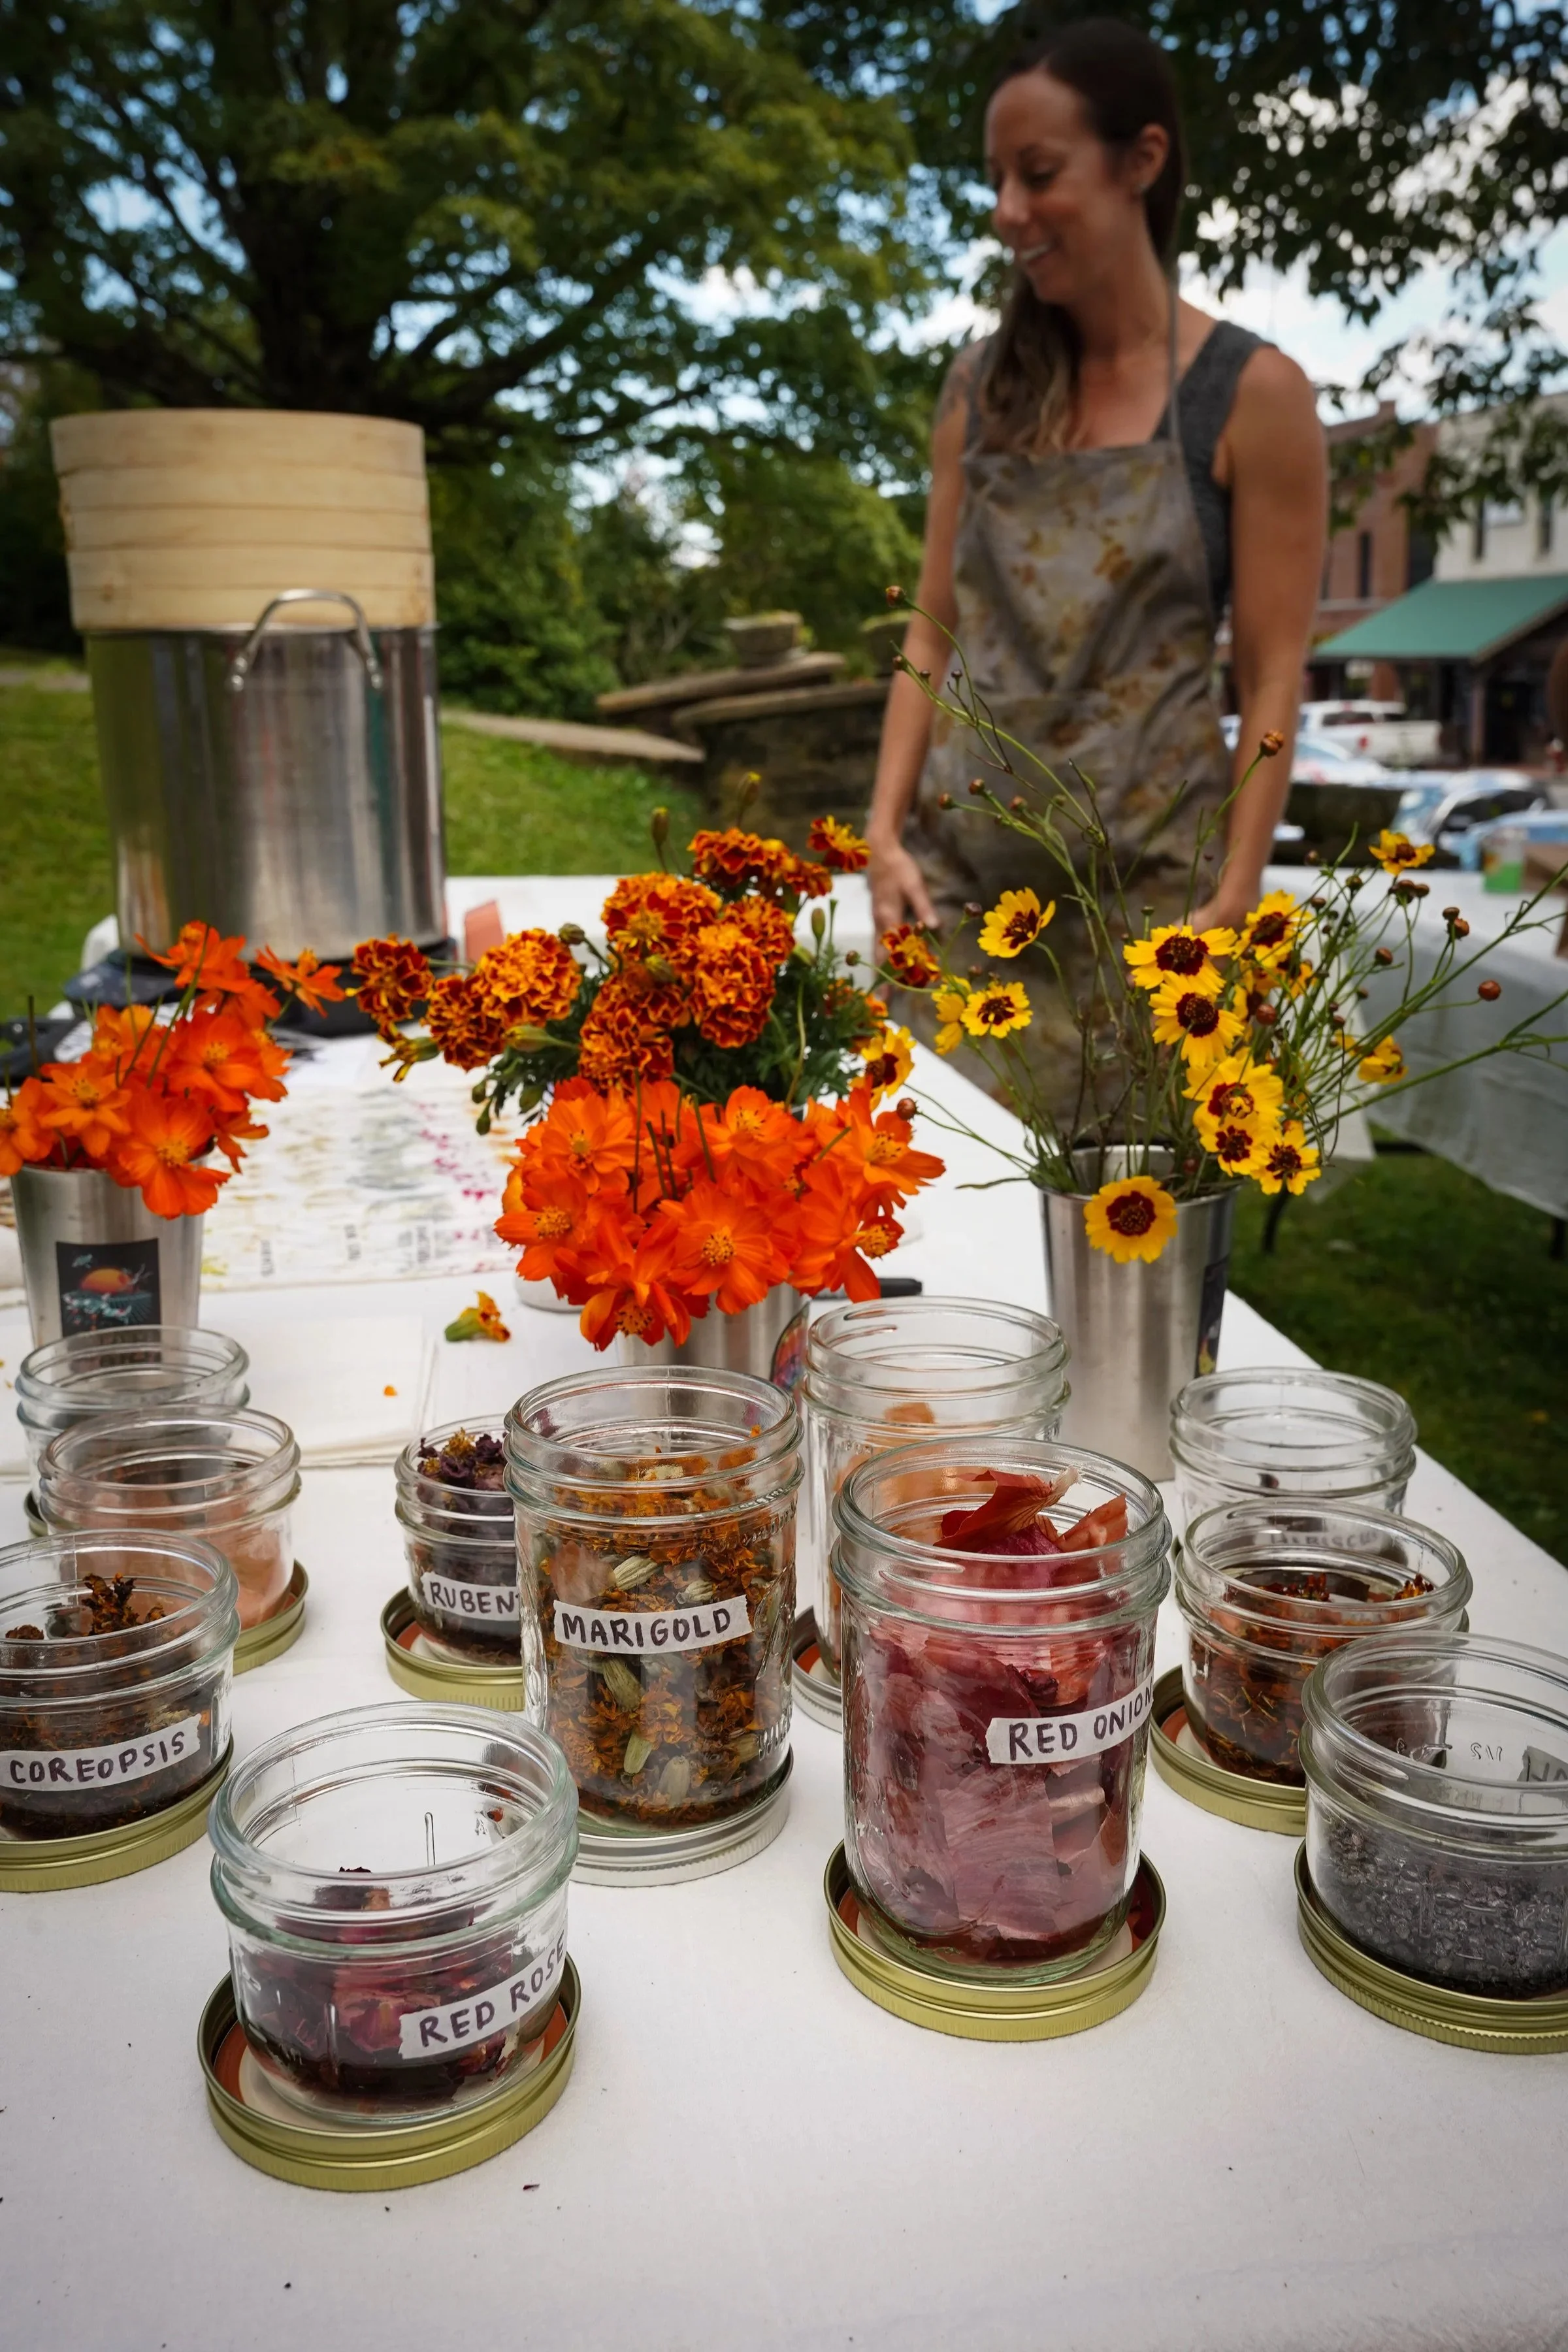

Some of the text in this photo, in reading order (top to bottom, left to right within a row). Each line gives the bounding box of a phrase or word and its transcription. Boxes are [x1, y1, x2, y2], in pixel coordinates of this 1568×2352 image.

[430, 1582, 519, 1614] RUBEN
[561, 1608, 731, 1647] MARIGOLD
[10, 1731, 185, 1784] COREOPSIS
[1009, 1722, 1077, 1761] RED
[419, 1929, 565, 2048] RED ROSE
